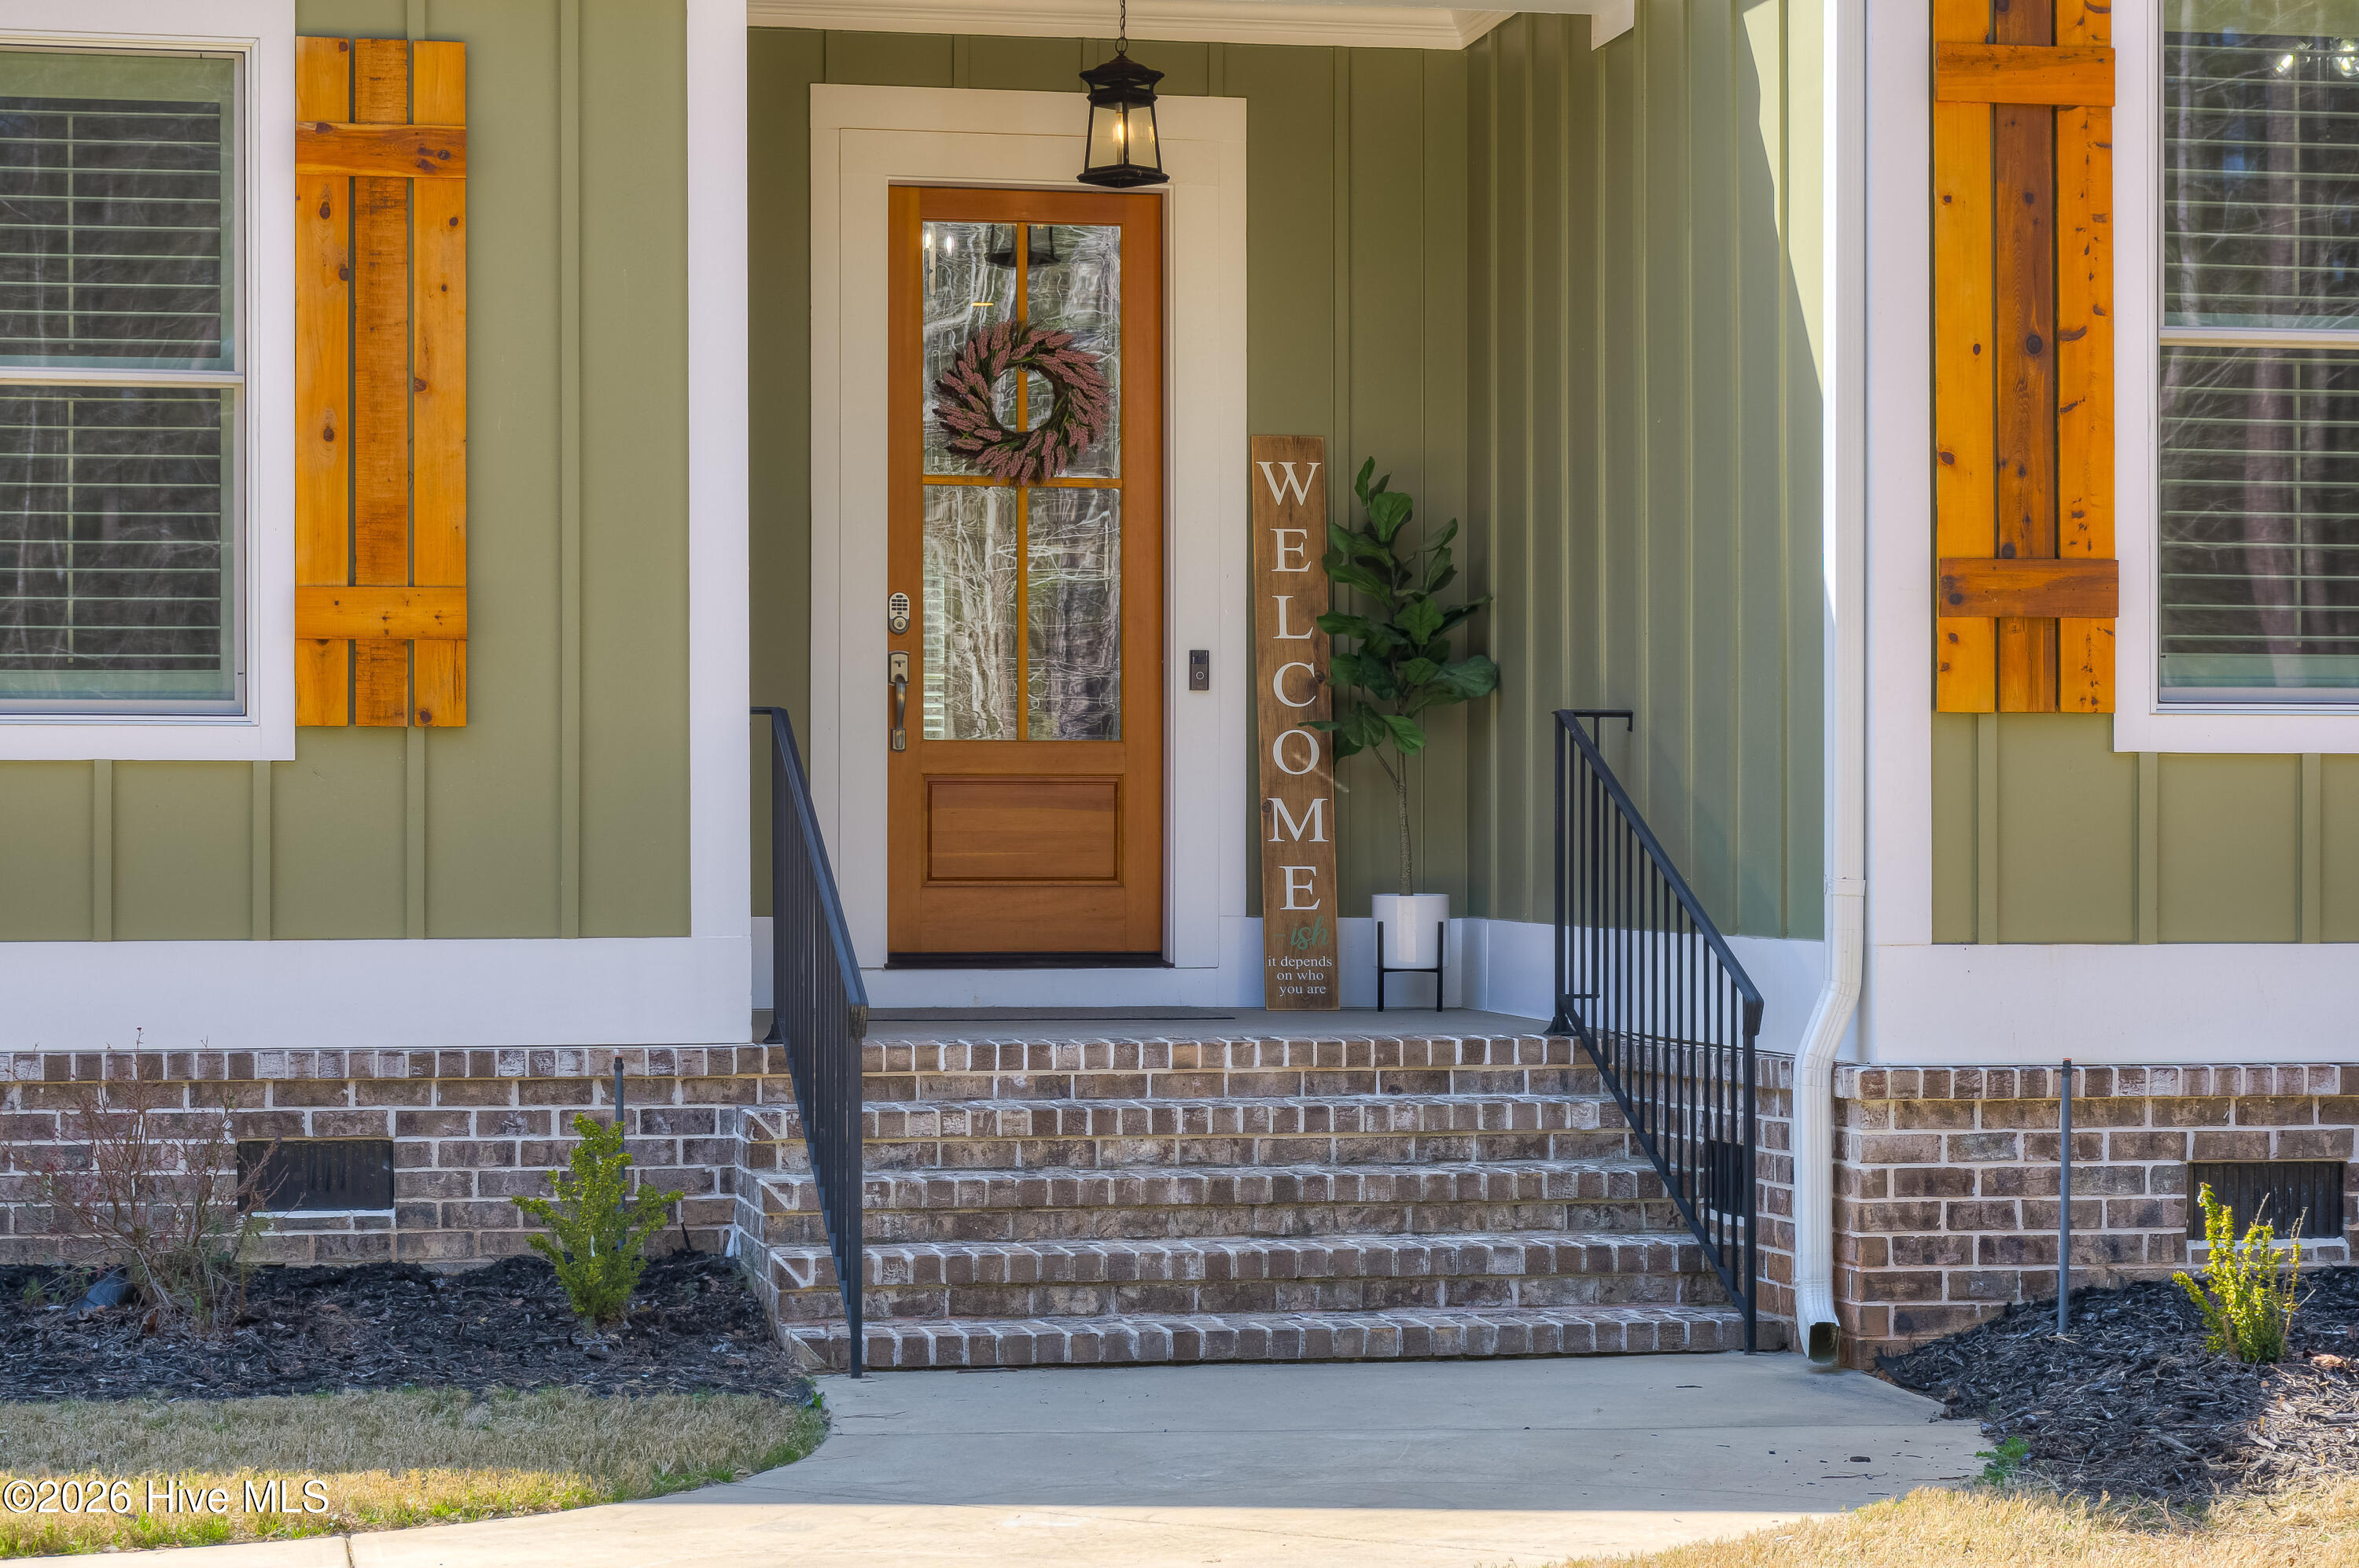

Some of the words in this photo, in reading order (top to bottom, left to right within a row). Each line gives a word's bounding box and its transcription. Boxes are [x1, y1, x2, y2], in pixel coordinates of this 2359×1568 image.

[1256, 461, 1329, 911] WELCOME
[1268, 955, 1277, 967] it
[1280, 955, 1333, 970] depends
[1276, 971, 1293, 981] on
[1297, 970, 1324, 981] who
[1279, 985, 1303, 997] you
[1307, 985, 1327, 994] are
